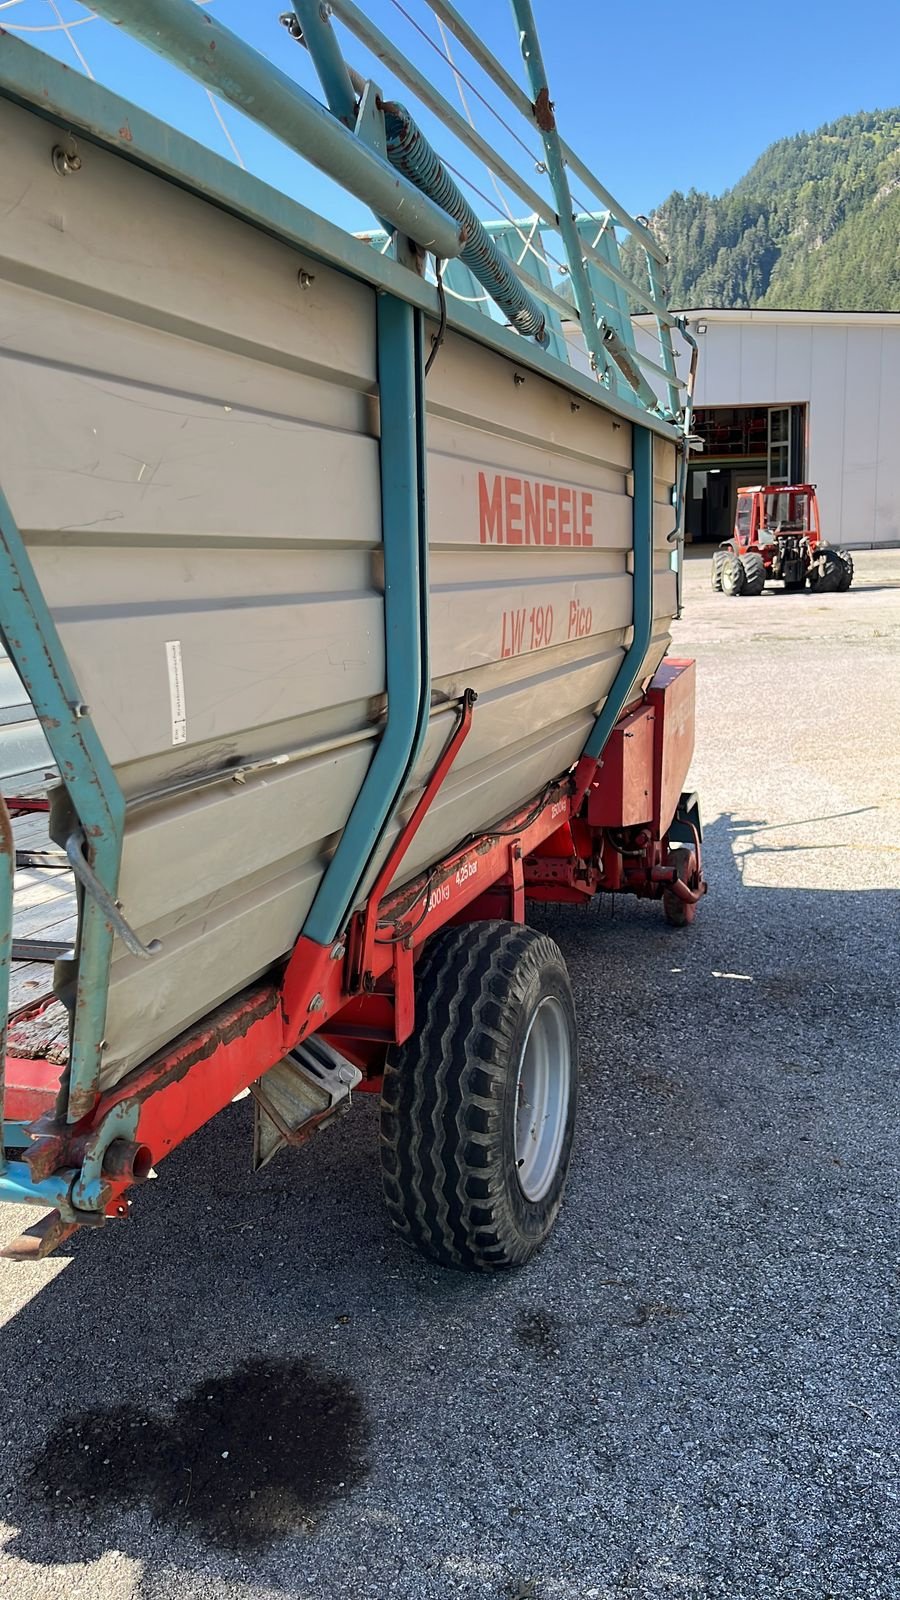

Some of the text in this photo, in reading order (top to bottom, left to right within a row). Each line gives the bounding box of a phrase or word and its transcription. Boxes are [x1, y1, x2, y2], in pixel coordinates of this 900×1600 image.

[478, 471, 594, 547] MENGELE
[501, 598, 593, 658] LW 190 Pico
[455, 864, 469, 887] 4,25
[468, 860, 478, 876] bar
